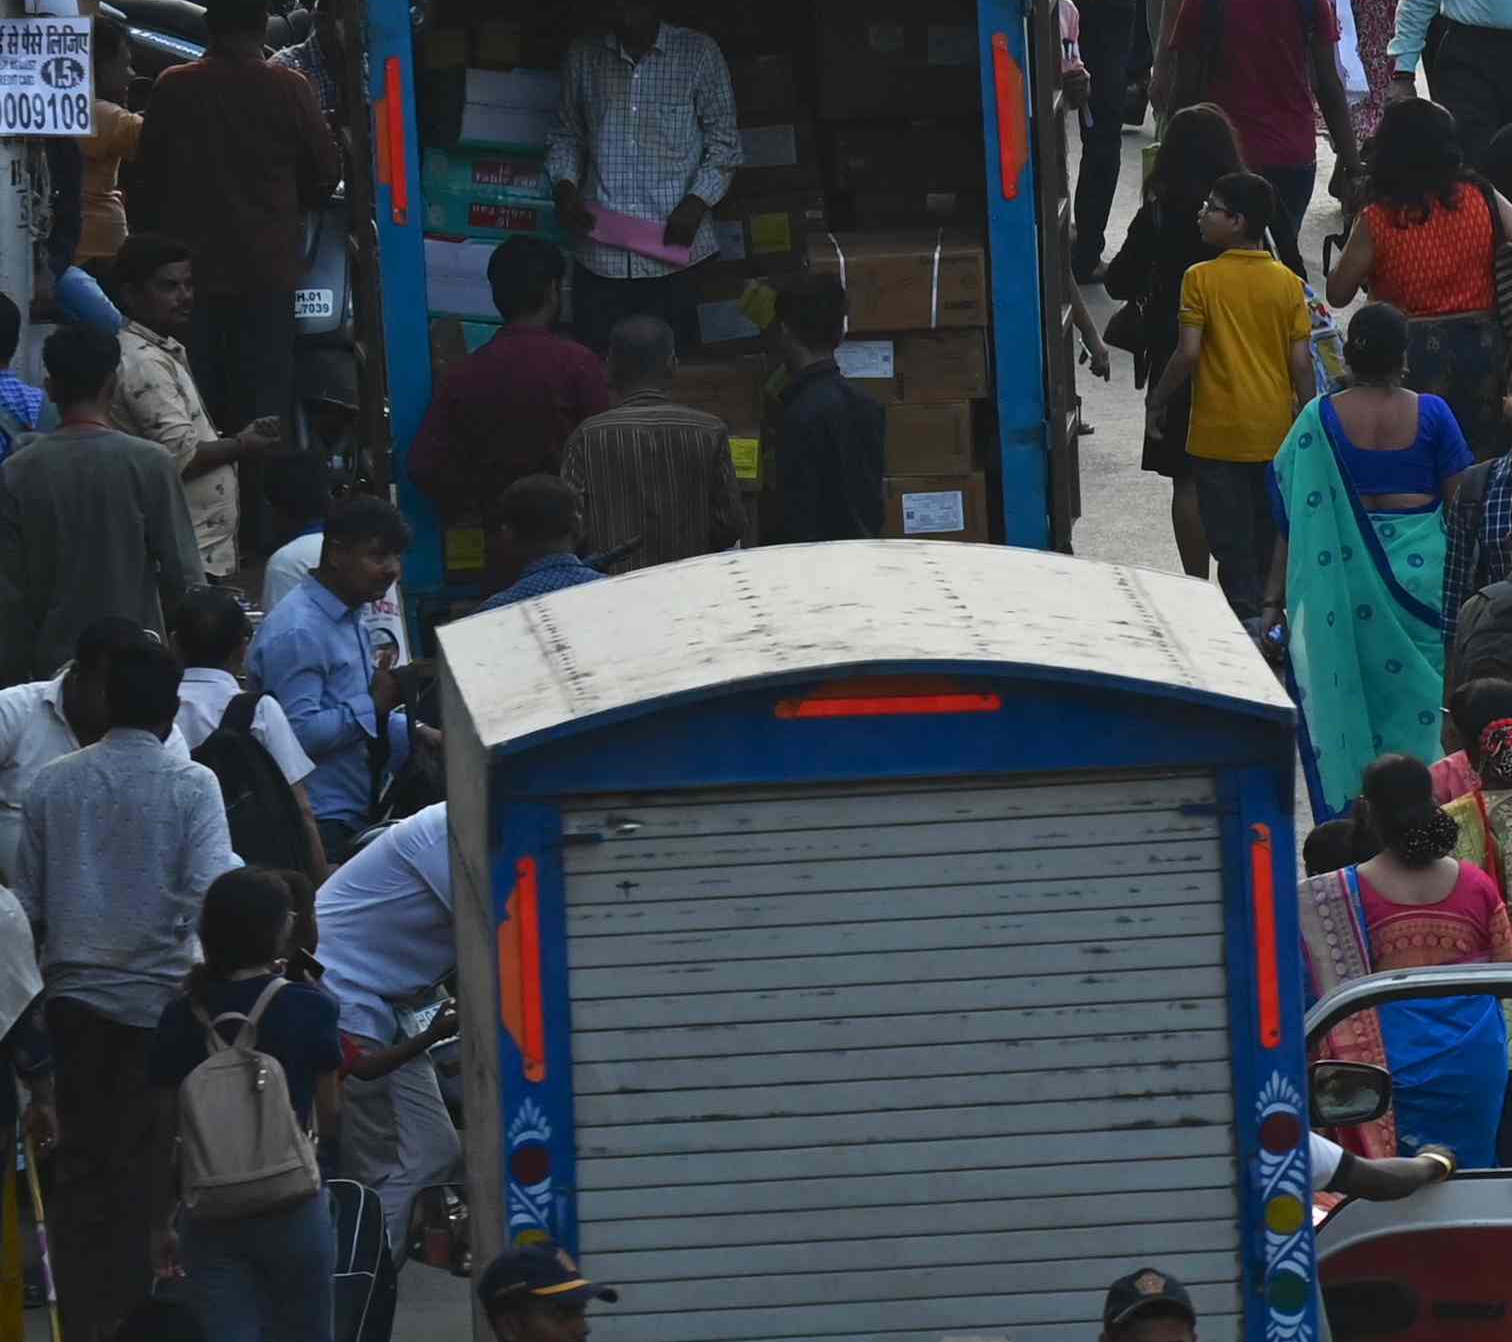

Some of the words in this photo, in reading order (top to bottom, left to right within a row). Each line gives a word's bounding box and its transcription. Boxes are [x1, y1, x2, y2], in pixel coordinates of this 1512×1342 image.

[7, 25, 22, 54] से
[22, 25, 43, 54] पैसे
[47, 25, 89, 54] लिजिए
